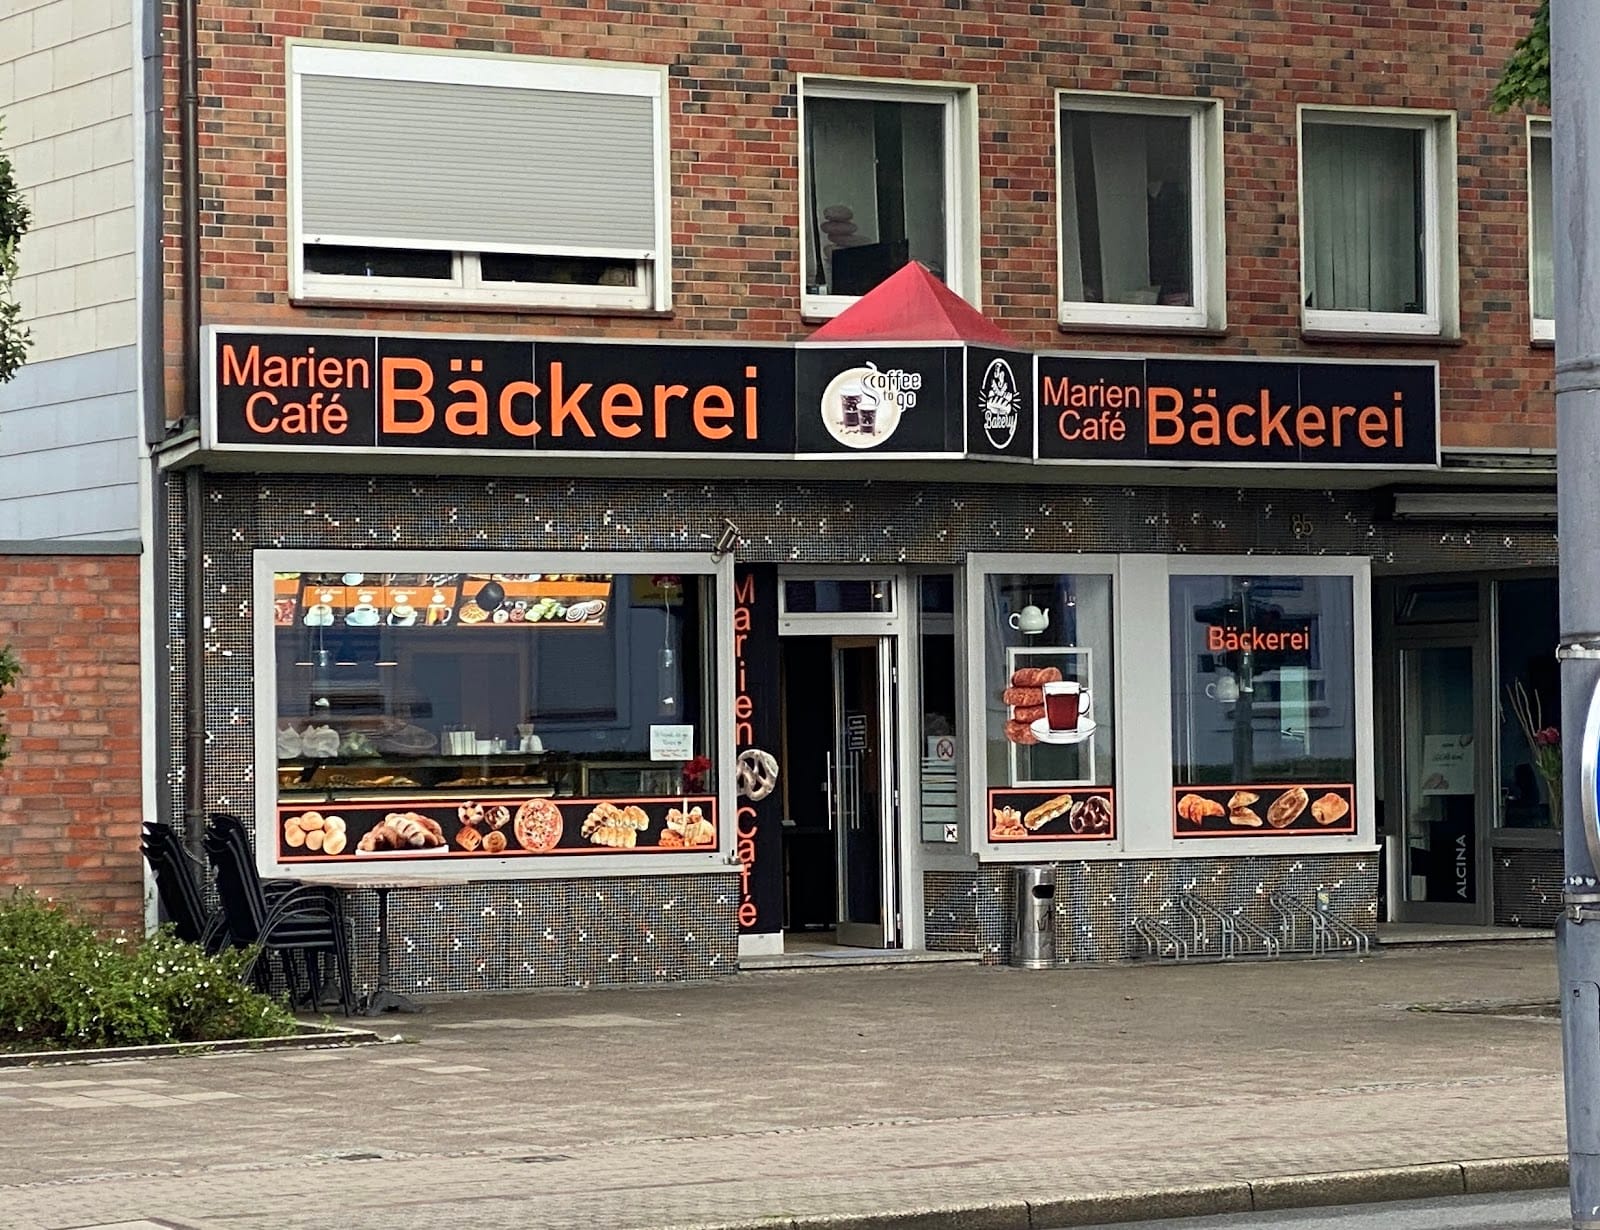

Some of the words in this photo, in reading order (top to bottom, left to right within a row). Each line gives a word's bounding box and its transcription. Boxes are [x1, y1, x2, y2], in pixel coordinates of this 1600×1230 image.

[222, 344, 370, 389] Marien
[245, 391, 349, 435] Café
[382, 357, 758, 440] Bäckerei
[883, 390, 894, 401] to
[896, 391, 917, 410] go
[1043, 376, 1140, 409] Marien
[984, 410, 1017, 435] Bakery
[1058, 410, 1126, 441] Café
[1147, 386, 1405, 448] Bäckerei
[734, 573, 755, 746] Marien
[1208, 626, 1309, 651] Bäckerei
[736, 806, 757, 927] Café
[1456, 834, 1467, 898] ALCINA
